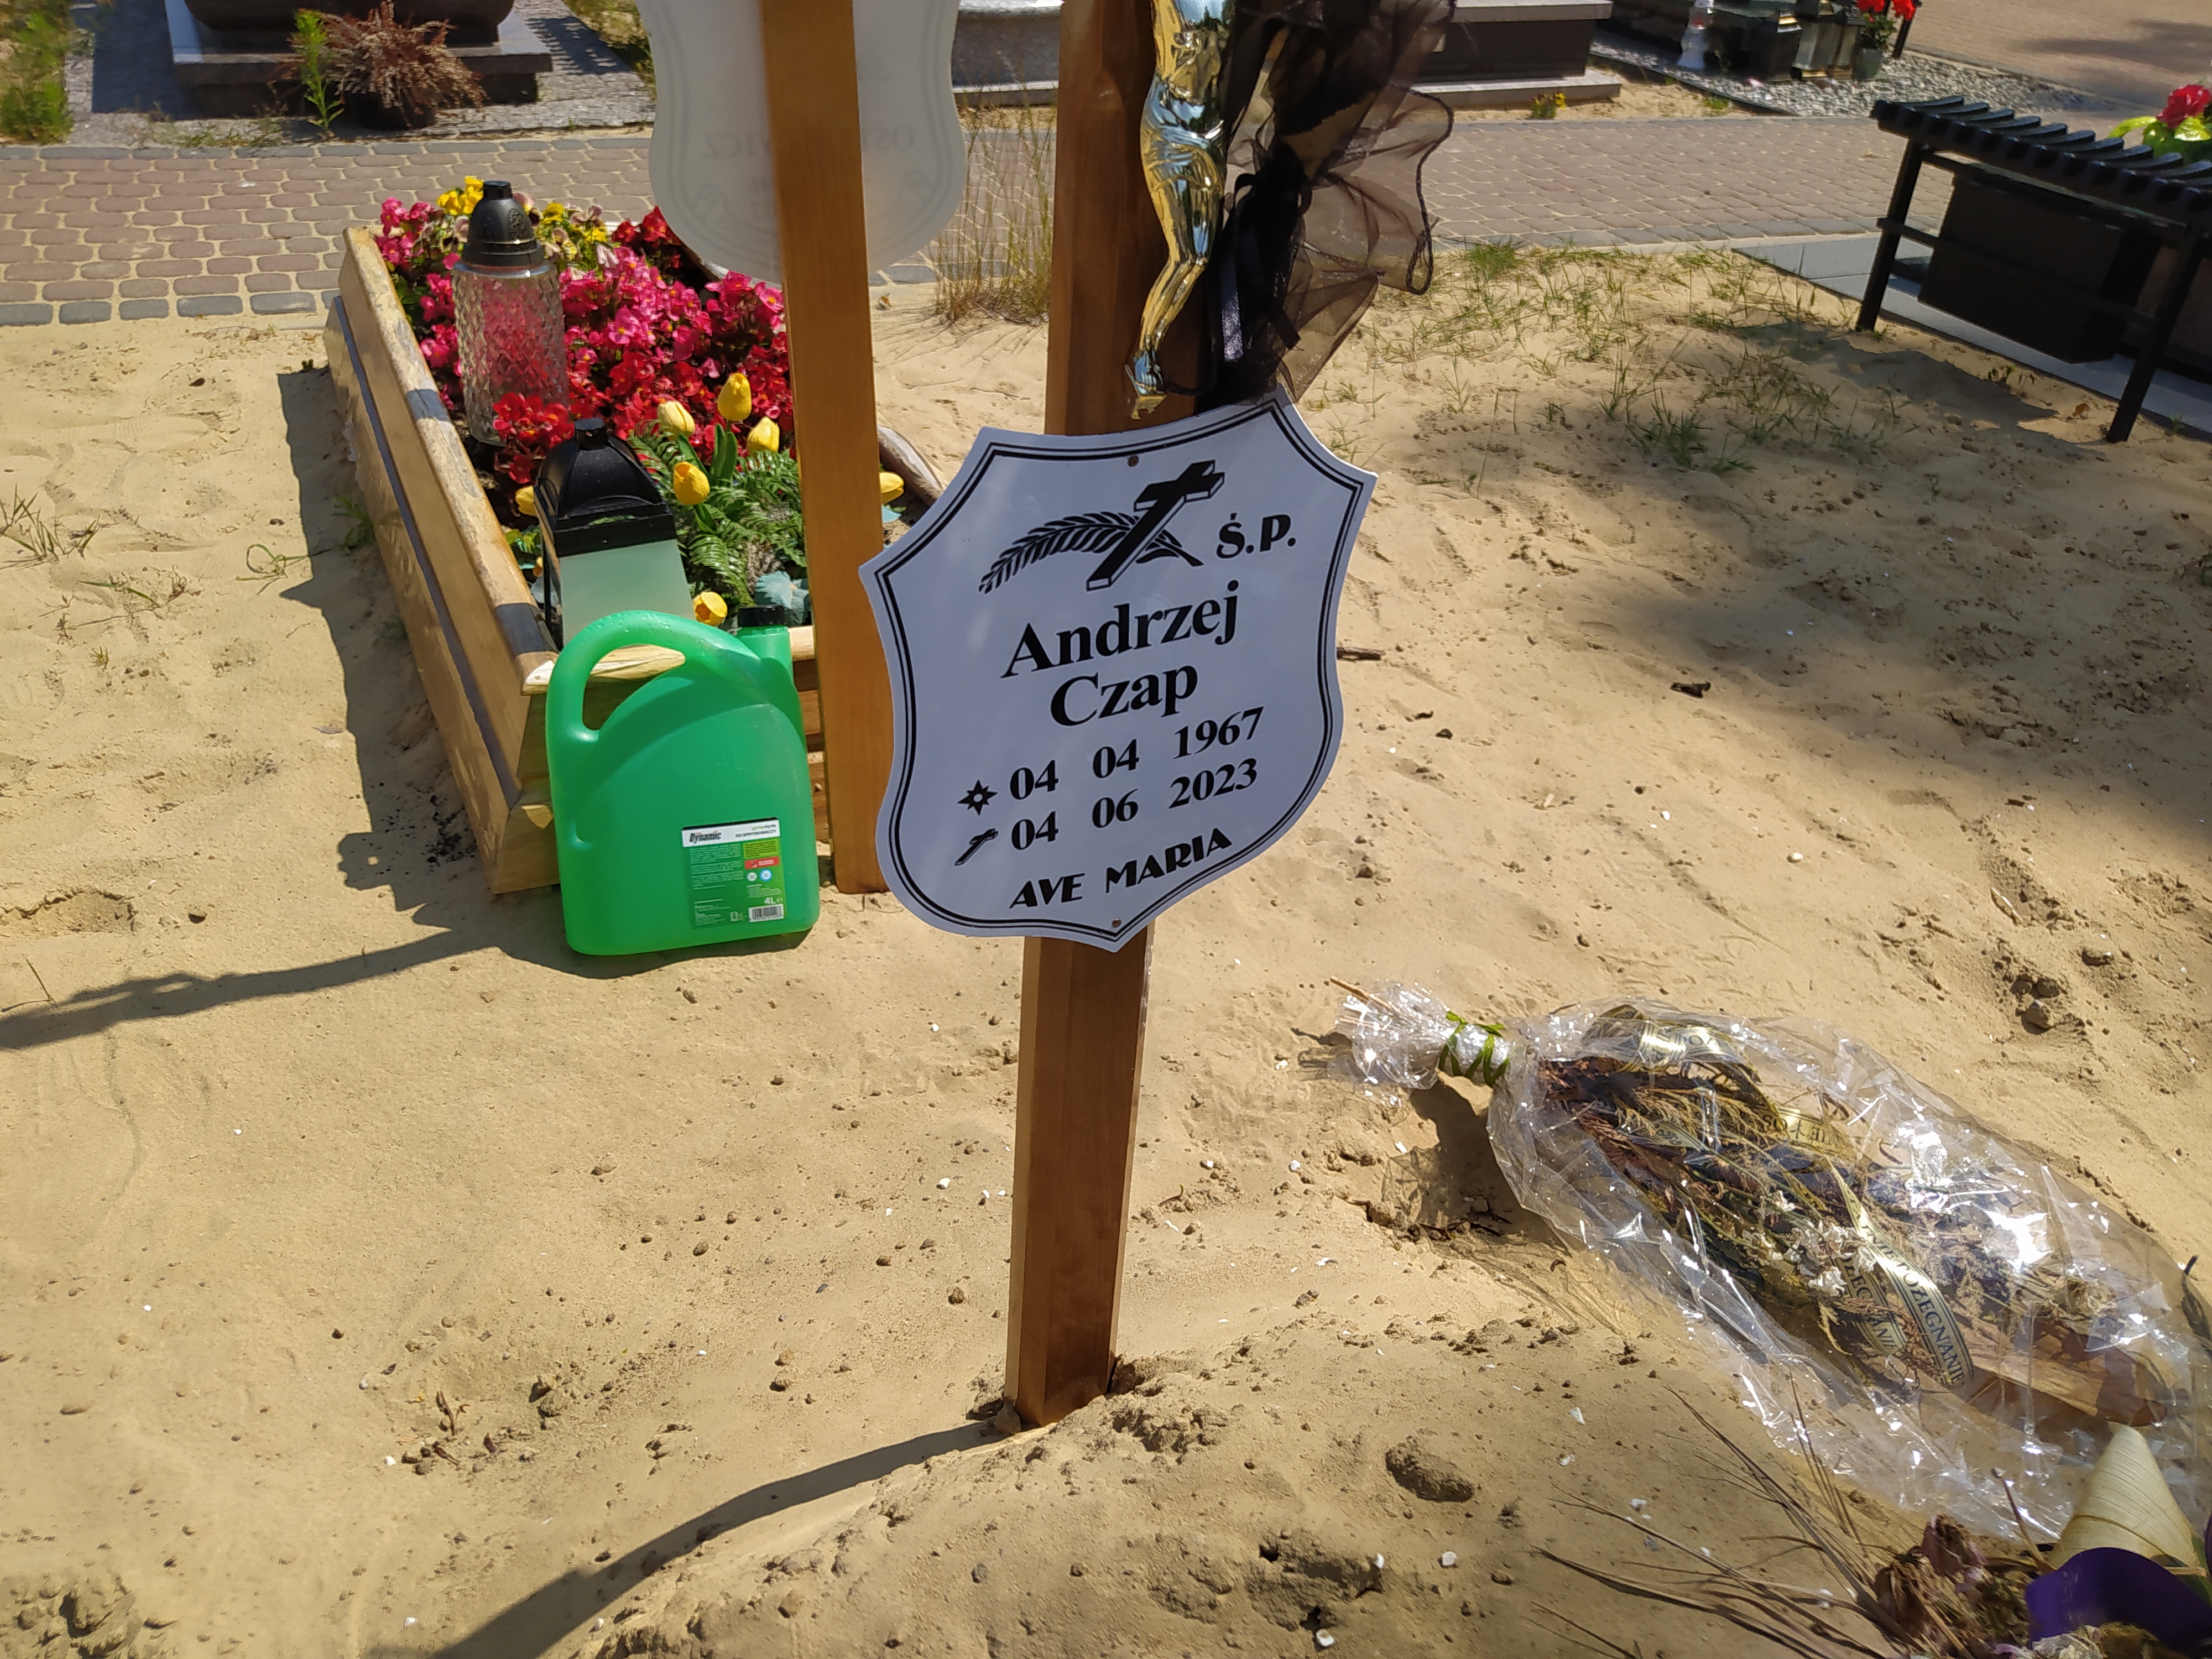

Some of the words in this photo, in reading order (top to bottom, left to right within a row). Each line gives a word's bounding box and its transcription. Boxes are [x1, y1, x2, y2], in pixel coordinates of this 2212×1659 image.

[1215, 512, 1297, 560] Ś.P.
[999, 579, 1240, 680] Andrzej
[1050, 665, 1198, 727] Czap
[1009, 759, 1060, 801] 04
[1092, 738, 1140, 779] 04
[1172, 705, 1265, 760] 1967
[689, 832, 722, 844] Dynamic
[1010, 810, 1060, 851] 04
[1091, 787, 1140, 829] 06
[1168, 757, 1258, 810] 2023
[1008, 872, 1087, 910] AVE
[1104, 827, 1234, 894] MARIA
